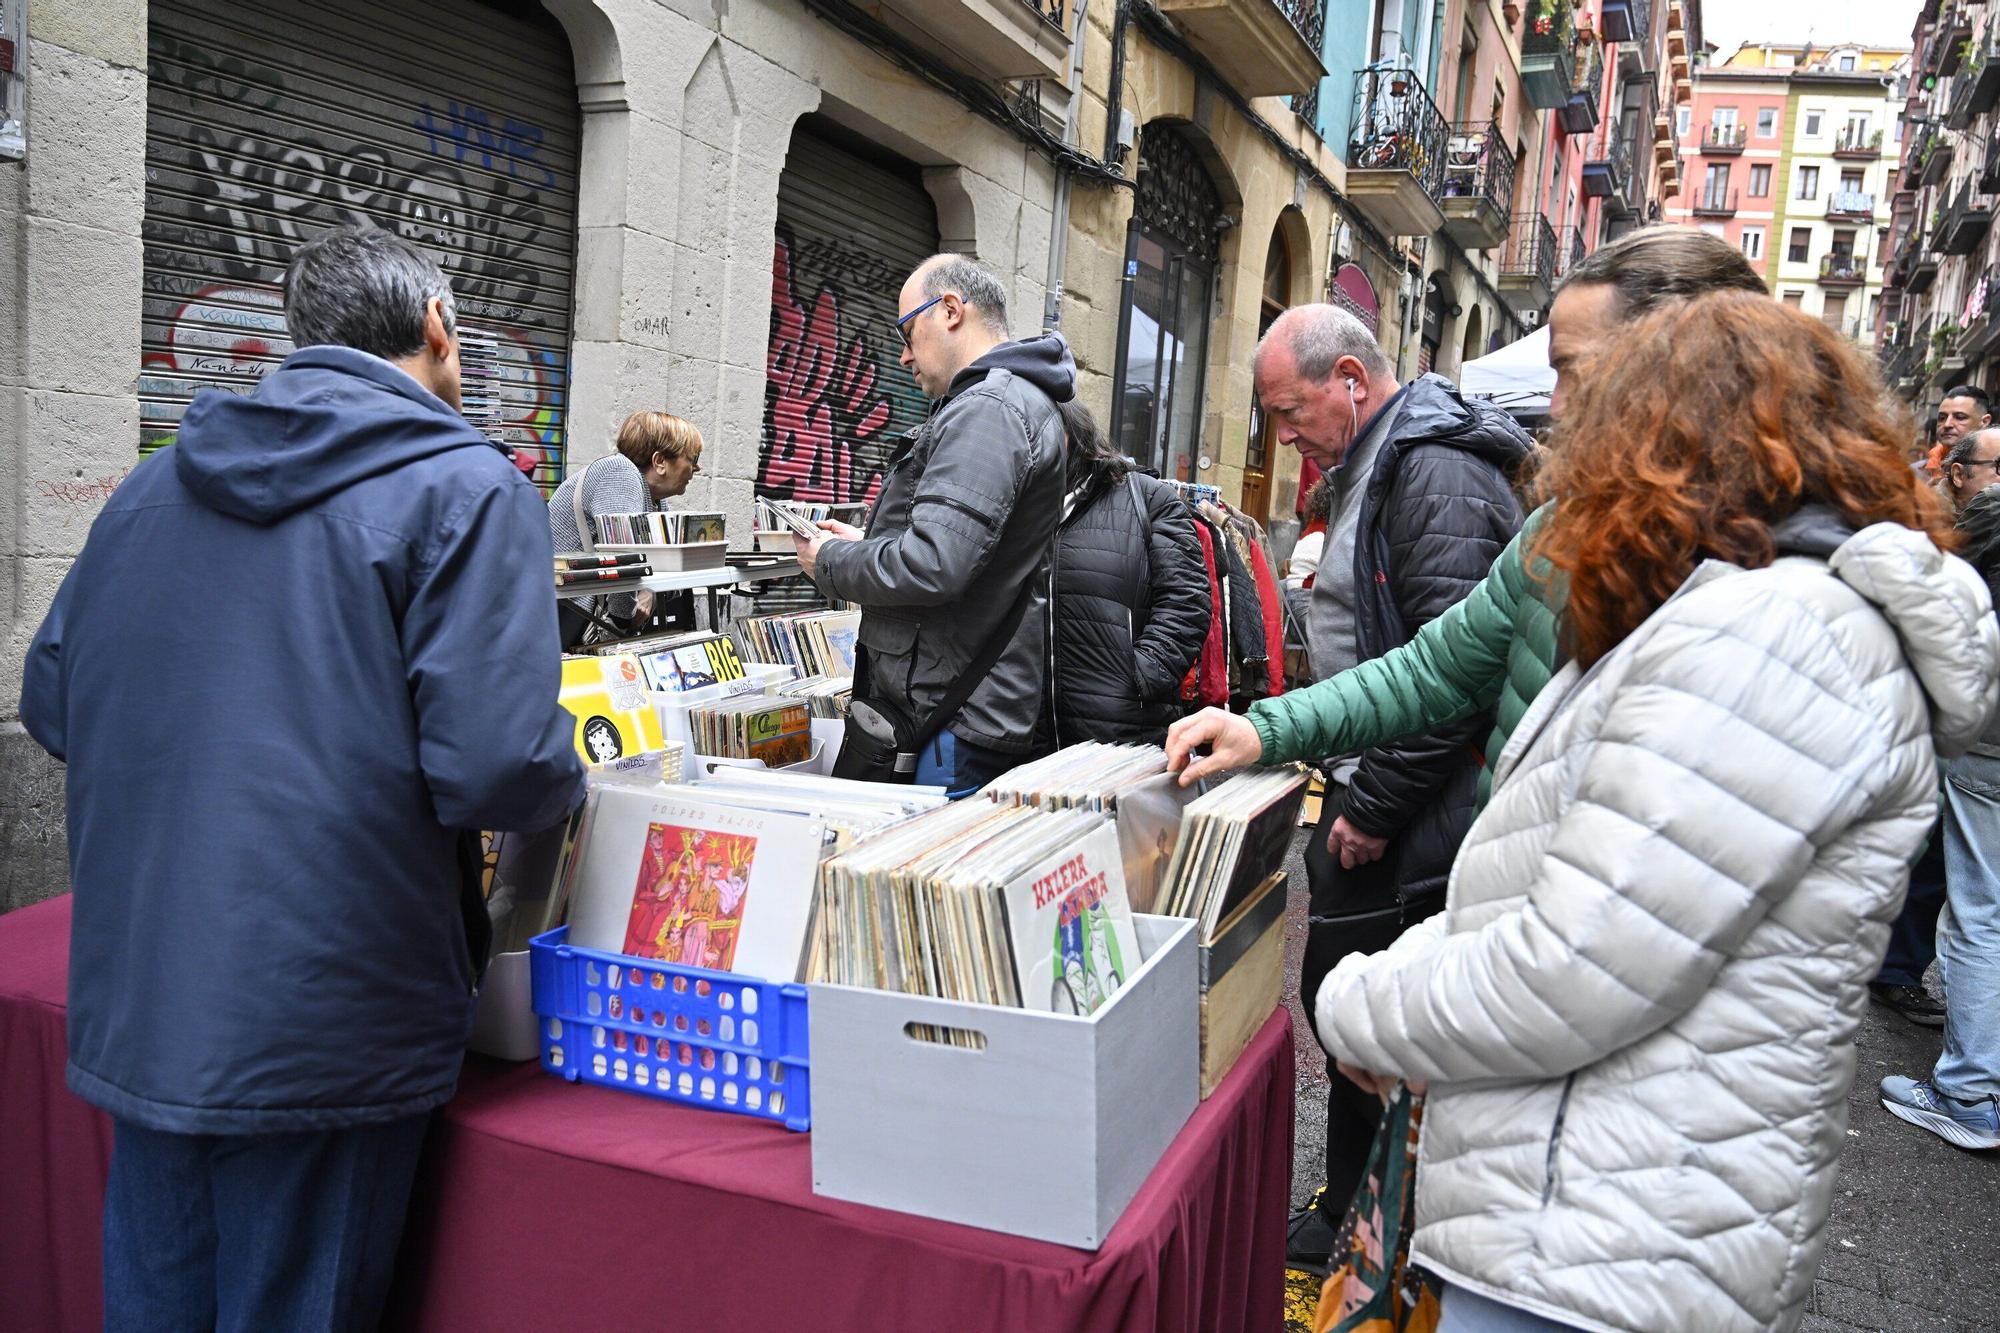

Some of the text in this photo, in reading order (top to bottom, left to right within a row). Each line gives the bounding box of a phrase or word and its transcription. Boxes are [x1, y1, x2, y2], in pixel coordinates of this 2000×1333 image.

[634, 316, 670, 336] OMAR
[704, 637, 745, 683] BIG
[651, 803, 706, 820] GOLPES
[1032, 853, 1088, 910] KALERA
